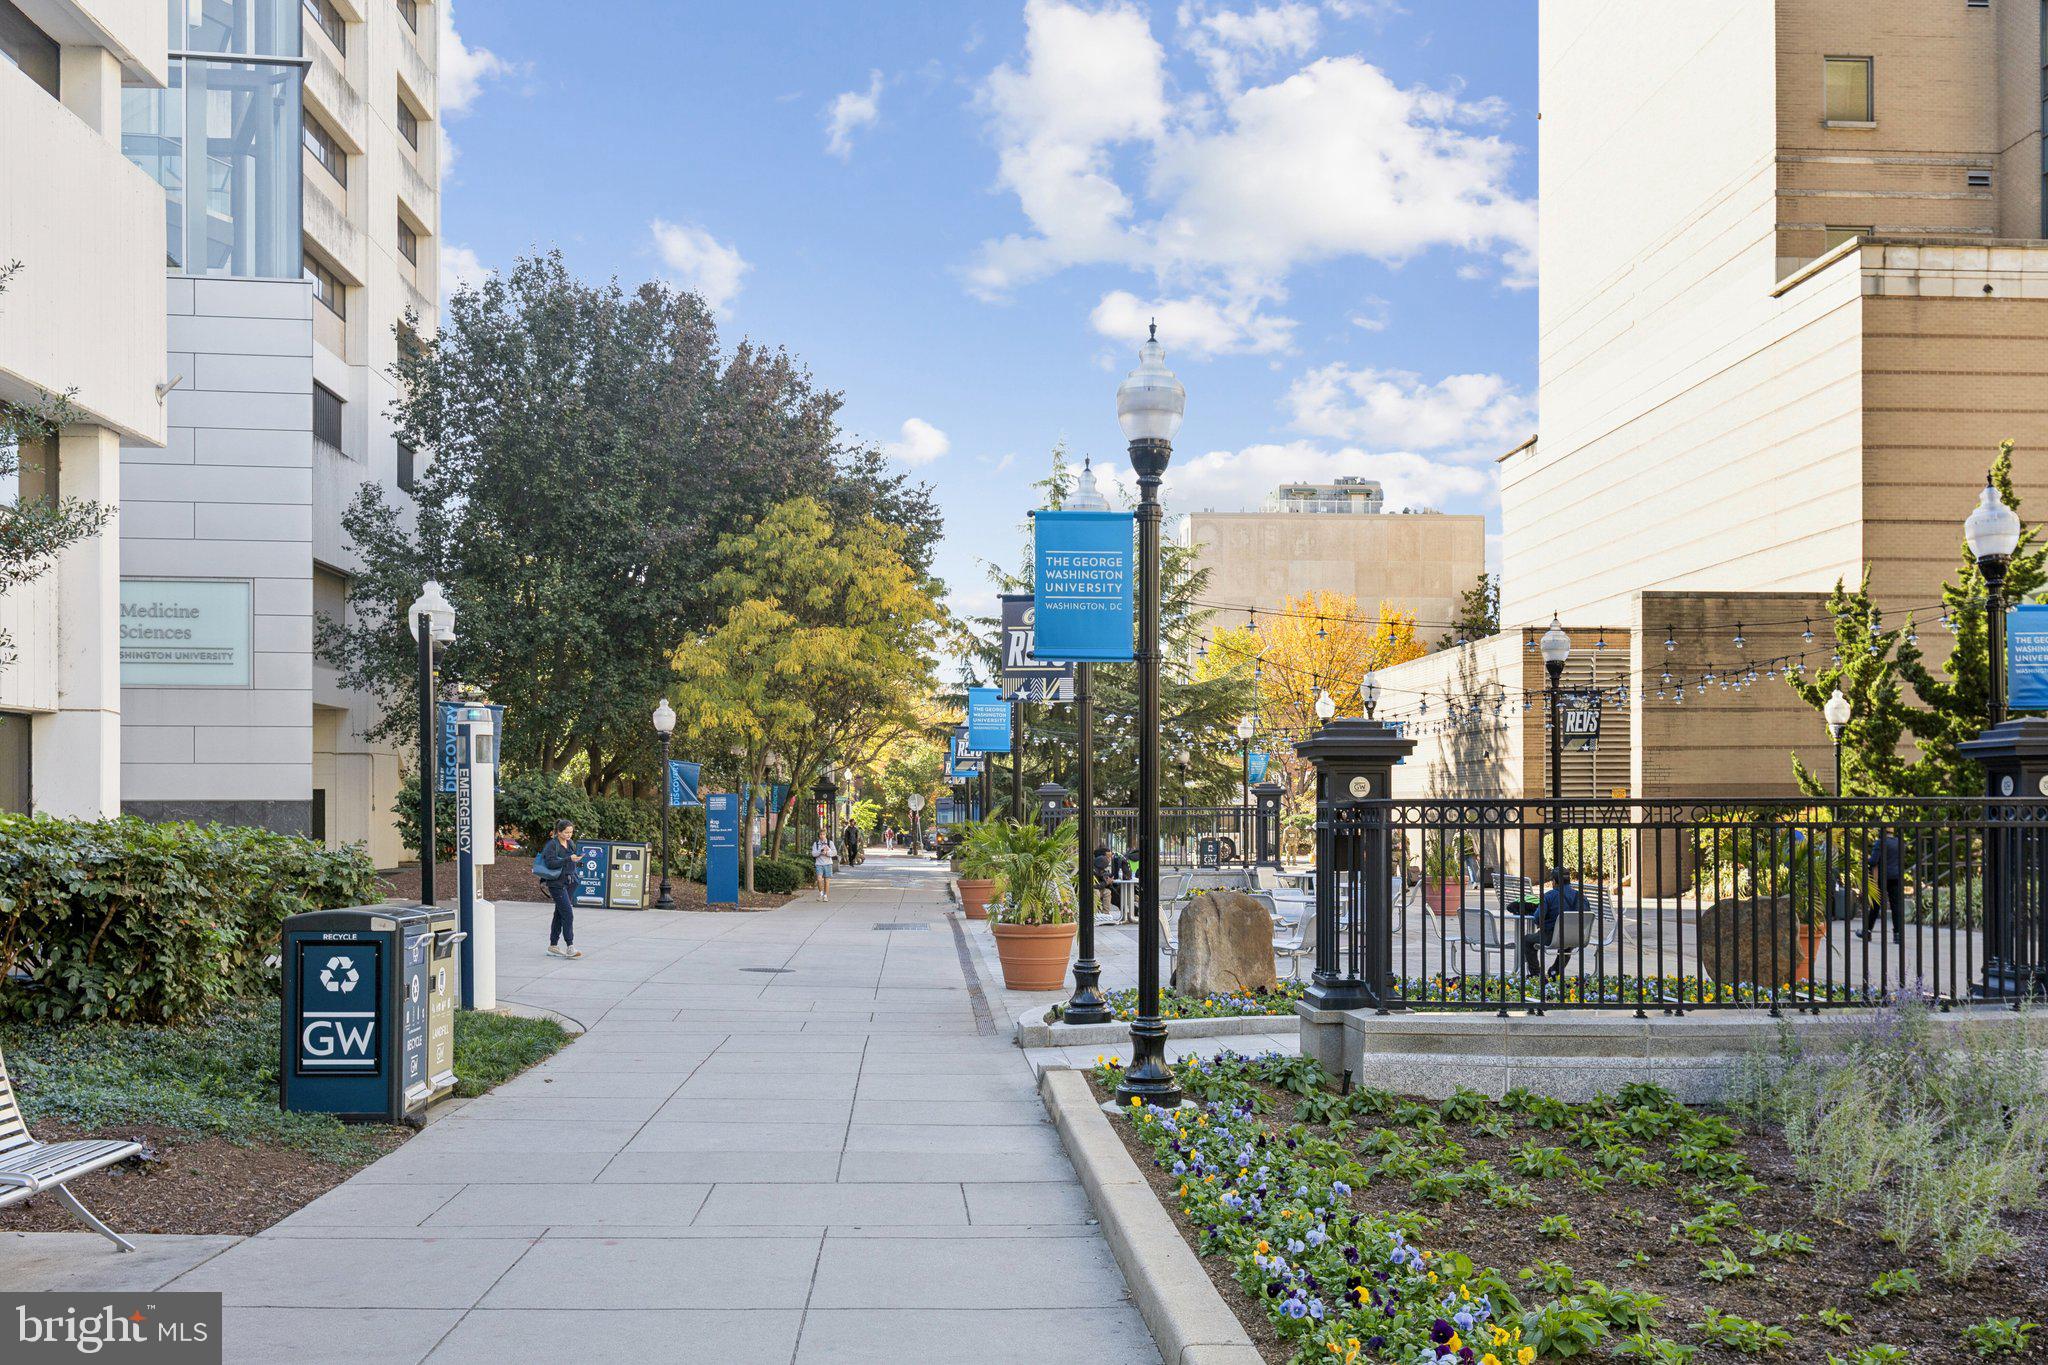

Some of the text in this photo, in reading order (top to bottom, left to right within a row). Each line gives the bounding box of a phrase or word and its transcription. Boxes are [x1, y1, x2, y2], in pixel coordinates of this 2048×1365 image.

[1045, 556, 1123, 567] THE GEORGE
[1045, 569, 1123, 580] WASHINGTON
[1045, 582, 1122, 593] UNIVERSITY
[120, 602, 200, 619] Medicine
[1045, 602, 1122, 612] WASHINGTON, DC
[120, 623, 192, 640] Sciences
[2015, 636, 2032, 644] THE
[174, 651, 234, 661] UNIVERSITY
[1565, 711, 1600, 732] REVS
[445, 704, 458, 793] DISCOVERY
[459, 768, 470, 855] EMERGENCY
[322, 933, 358, 941] RECYCLE
[302, 1020, 375, 1056] GW
[406, 1034, 423, 1052] RECYCLE
